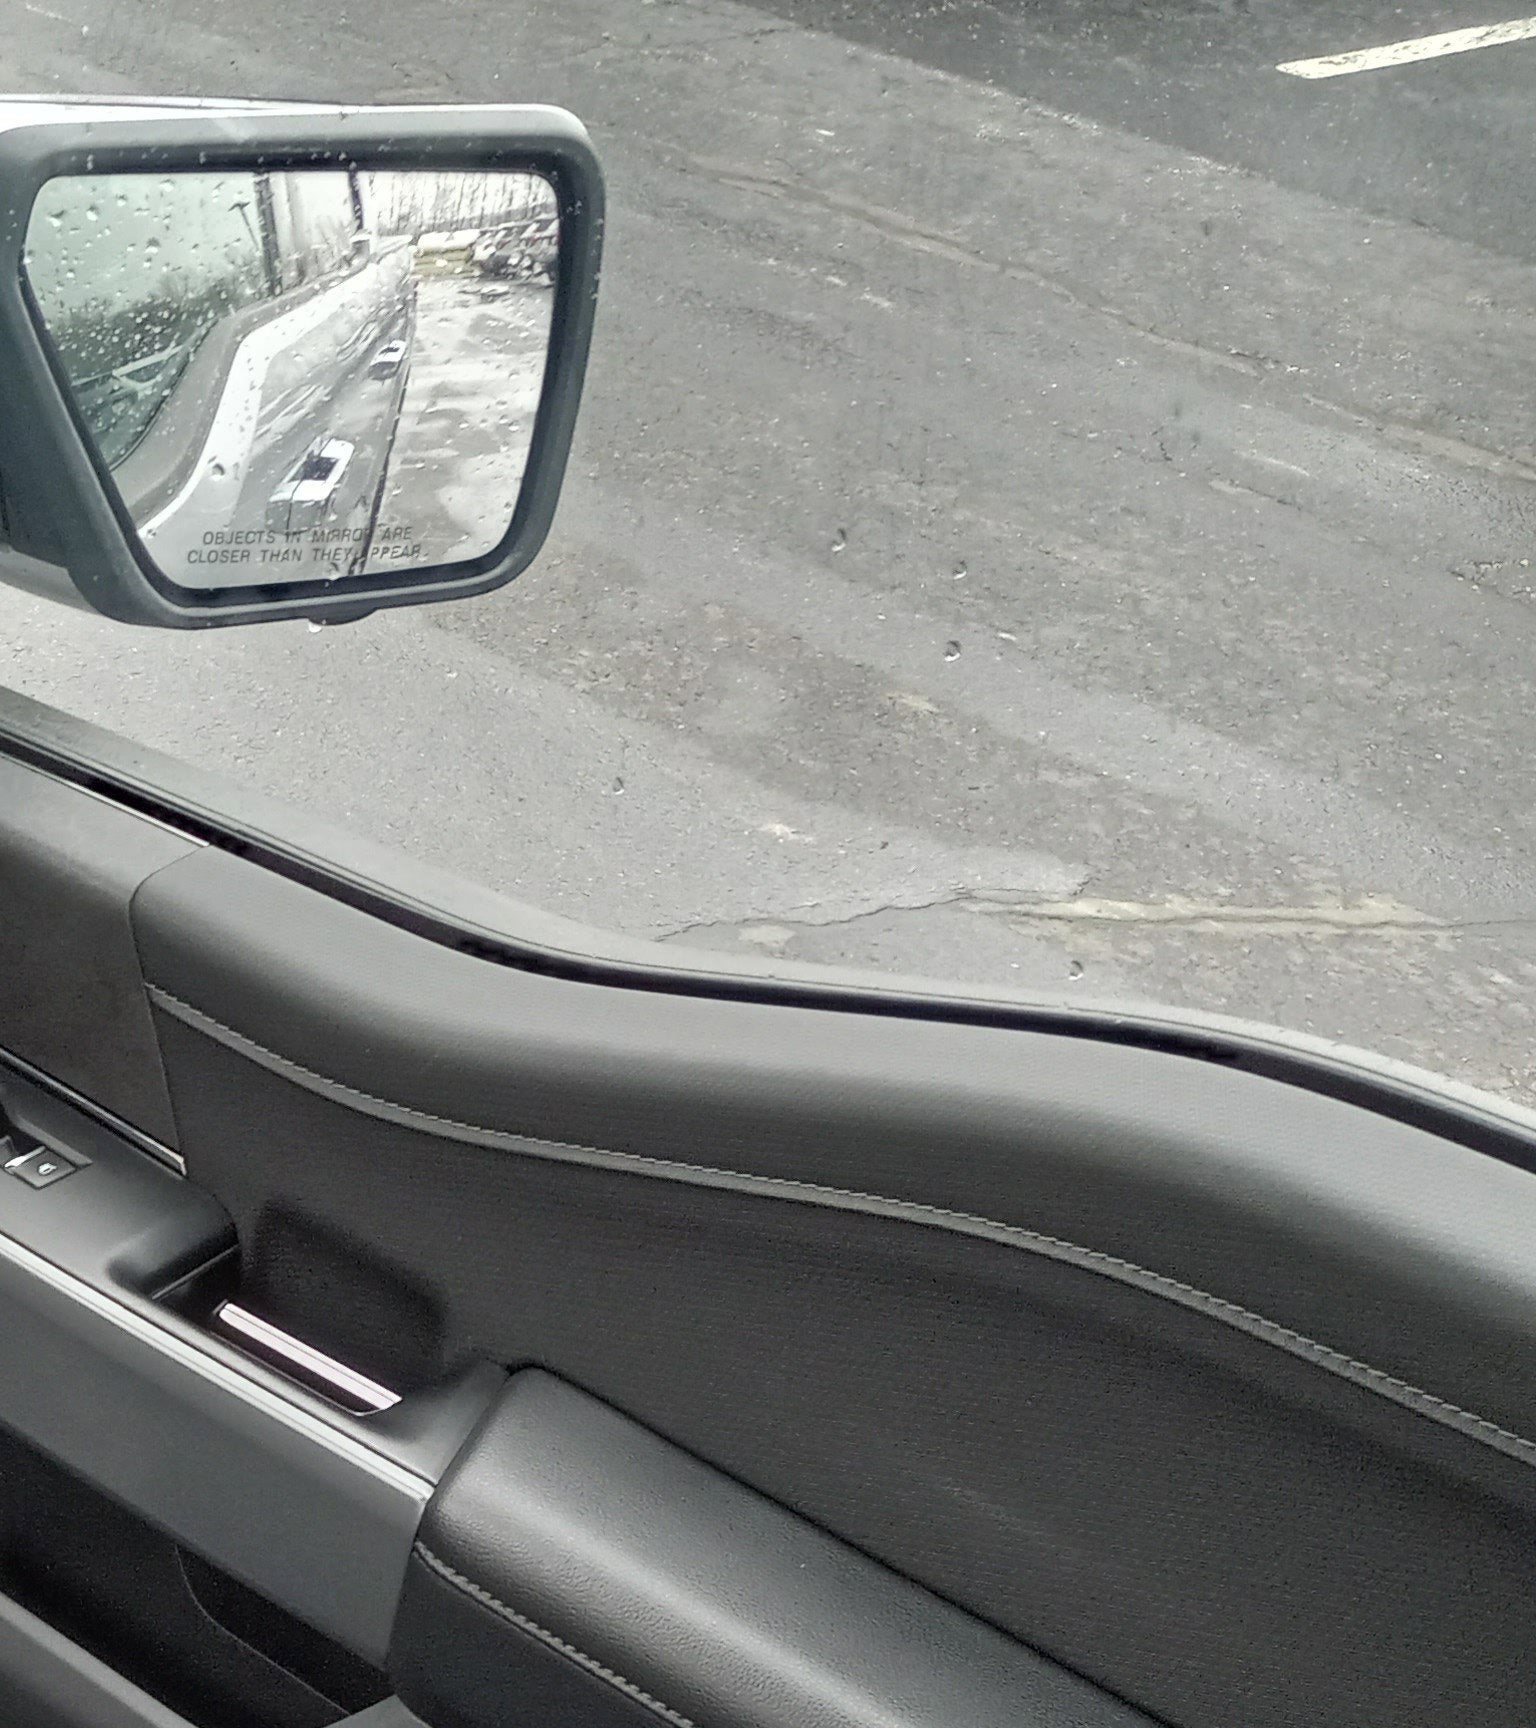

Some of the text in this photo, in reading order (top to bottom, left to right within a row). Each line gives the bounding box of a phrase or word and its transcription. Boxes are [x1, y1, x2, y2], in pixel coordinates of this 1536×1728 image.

[203, 530, 275, 545] OBJECTS
[382, 526, 412, 540] ARE
[188, 549, 251, 563] CLOSER
[261, 549, 302, 562] THAN
[312, 548, 352, 561] THEY
